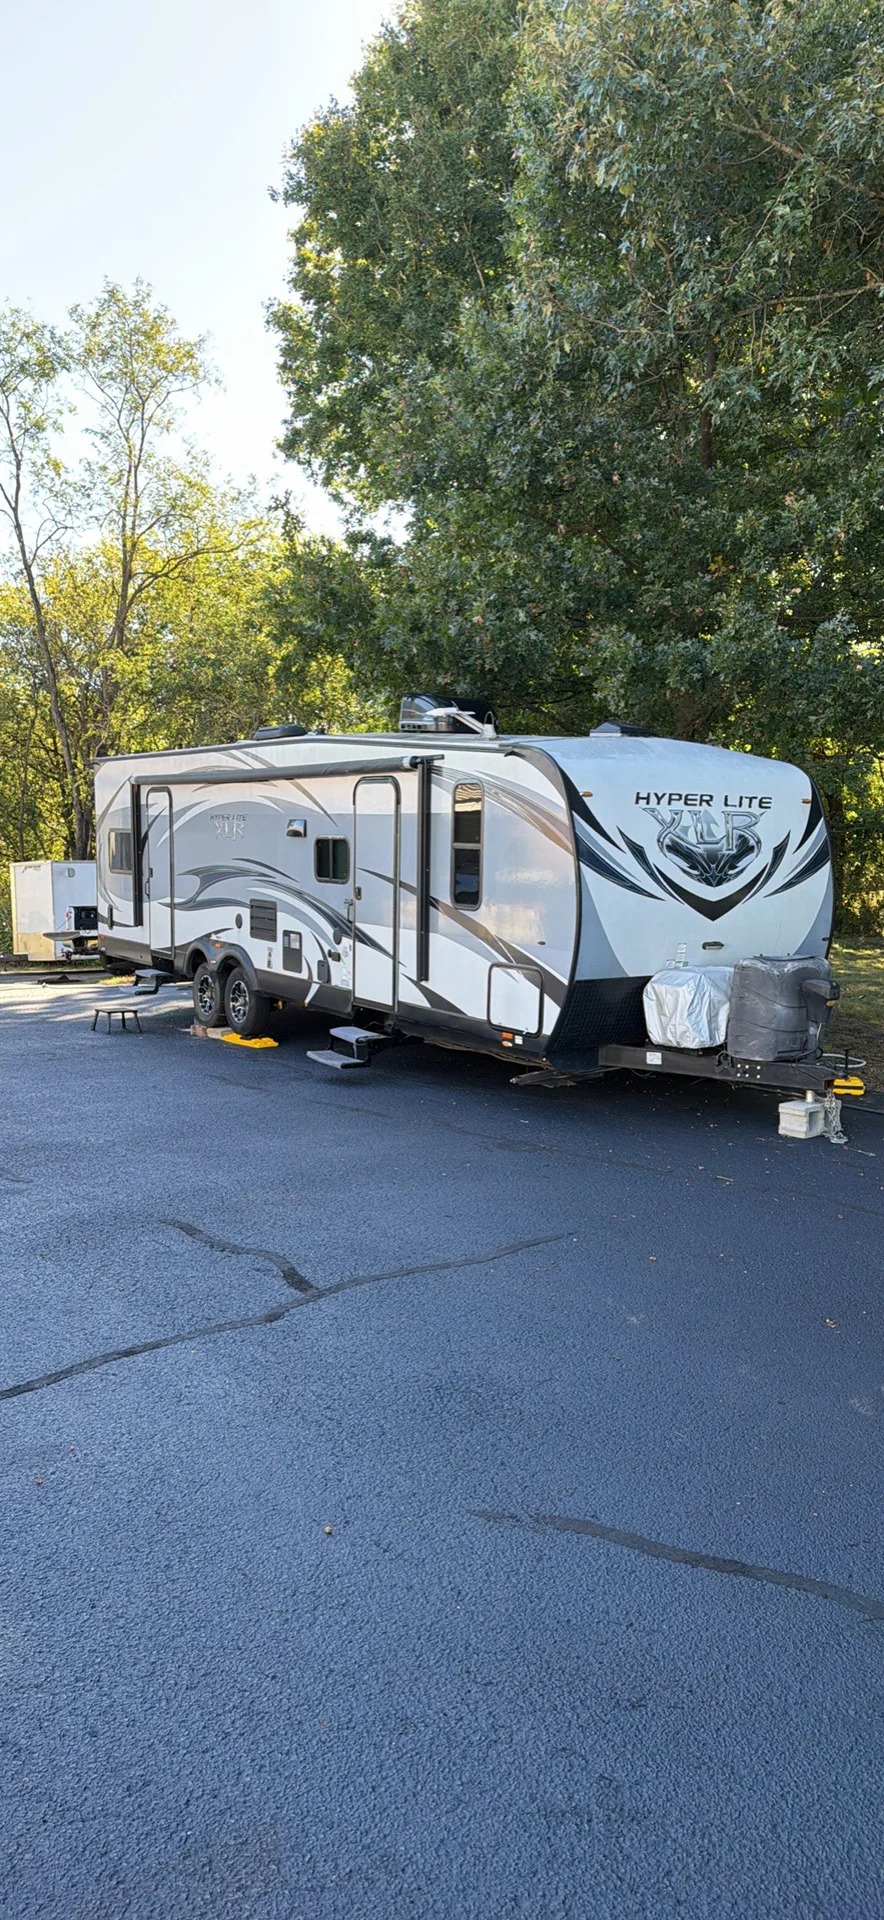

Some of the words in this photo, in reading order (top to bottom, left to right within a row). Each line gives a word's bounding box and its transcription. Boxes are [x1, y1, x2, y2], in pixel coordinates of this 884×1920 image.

[634, 791, 714, 807] HYPER
[724, 794, 773, 809] LITE
[210, 813, 230, 821] HYPER
[231, 813, 248, 821] LITE
[215, 820, 244, 841] XLR
[641, 807, 764, 858] XLR
